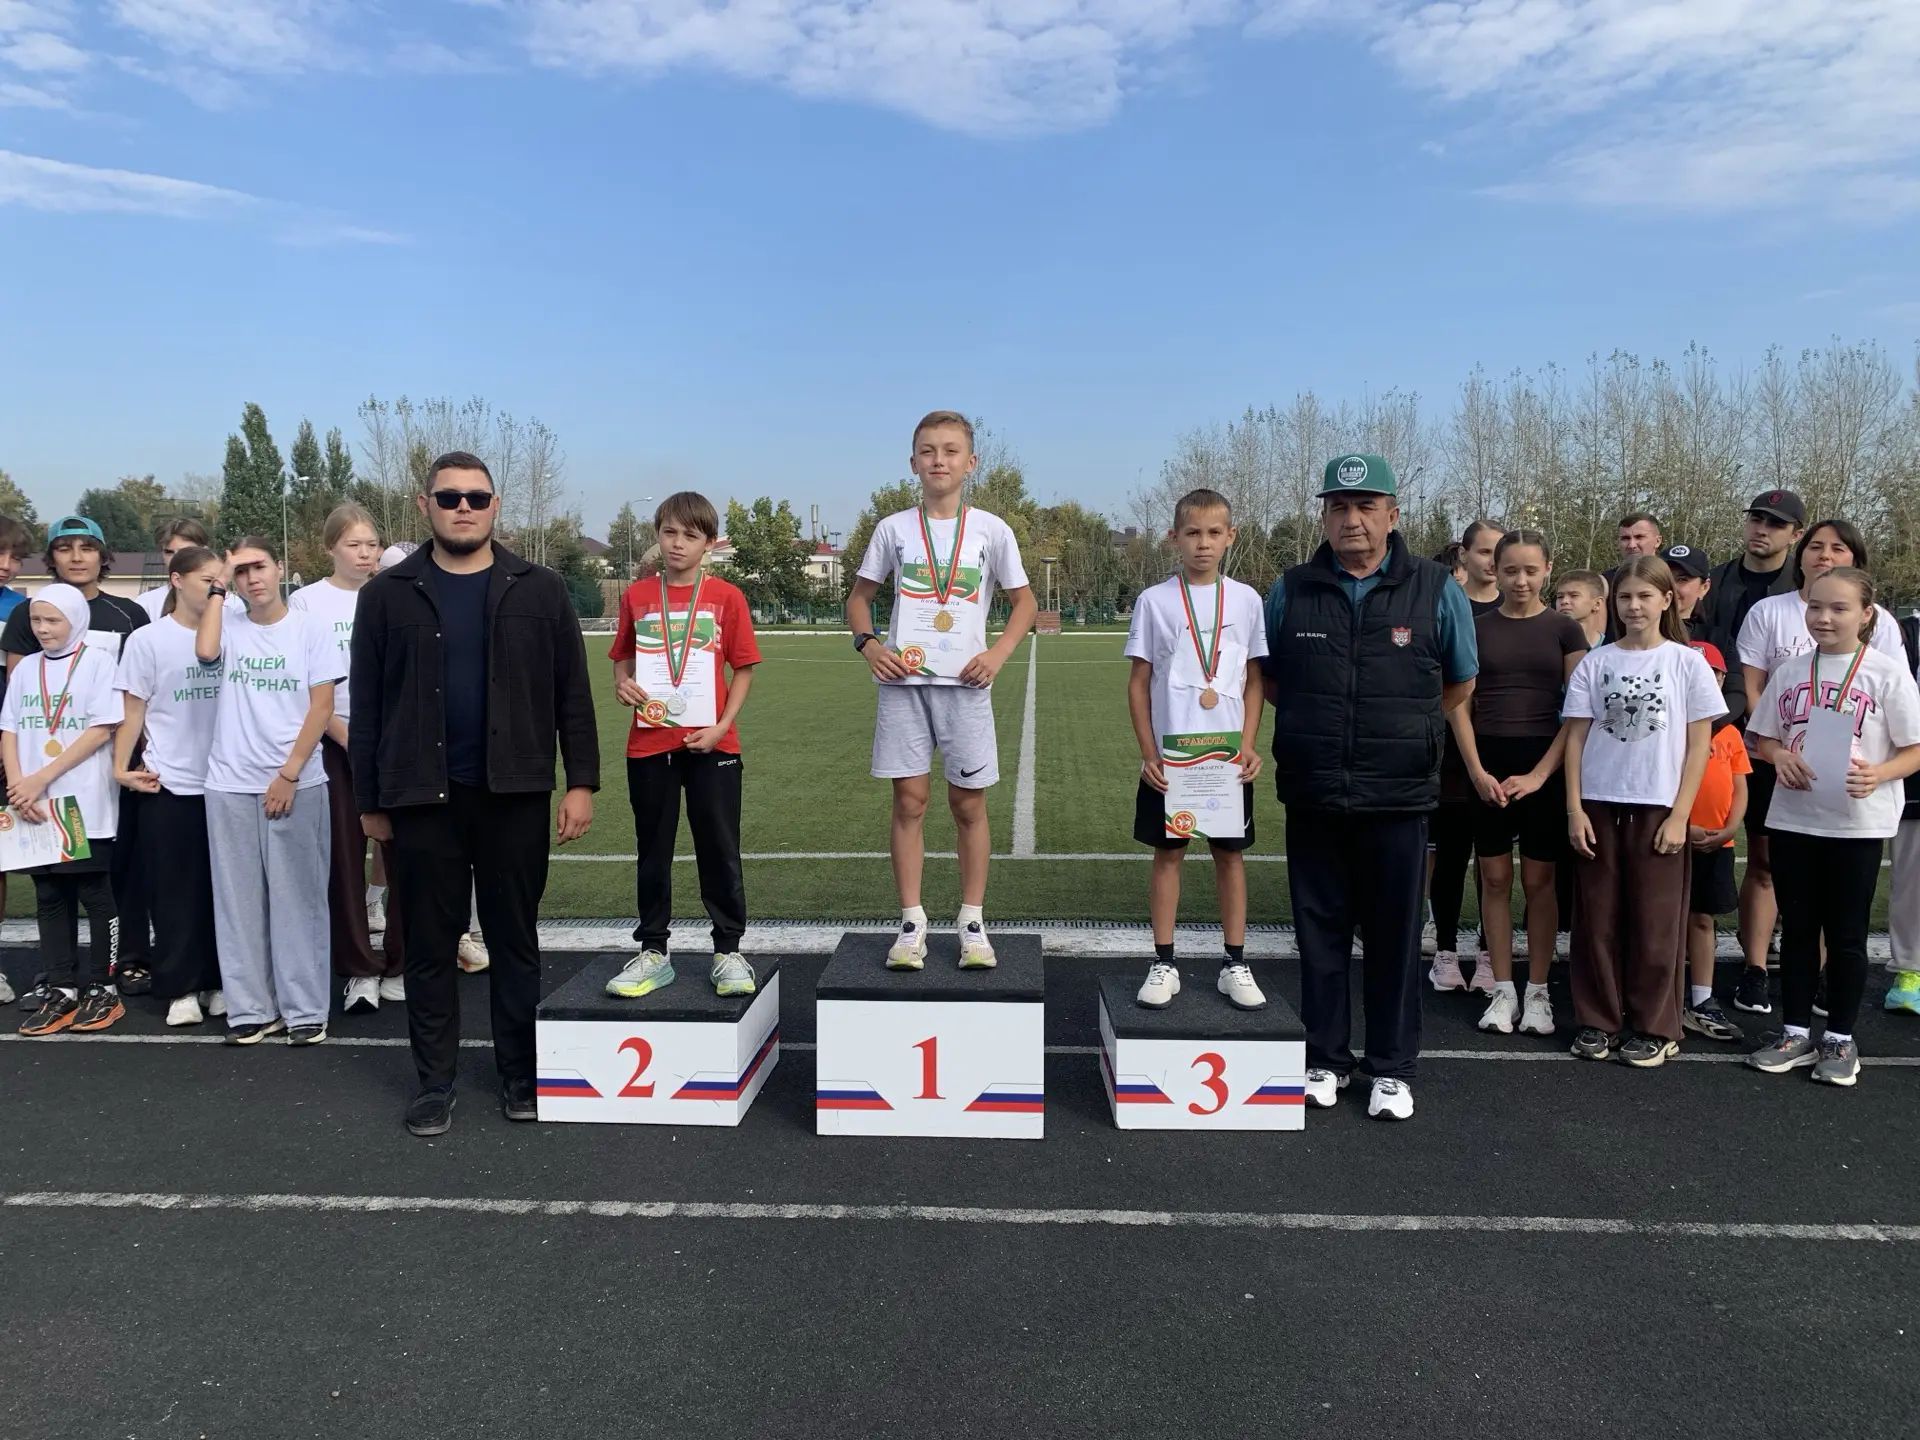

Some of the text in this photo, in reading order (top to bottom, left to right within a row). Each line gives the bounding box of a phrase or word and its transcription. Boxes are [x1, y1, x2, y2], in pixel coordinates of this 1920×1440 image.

[173, 686, 220, 702] ИНТЕР
[618, 1036, 656, 1098] 2
[913, 1036, 947, 1100] 1
[1188, 1052, 1229, 1115] 3
